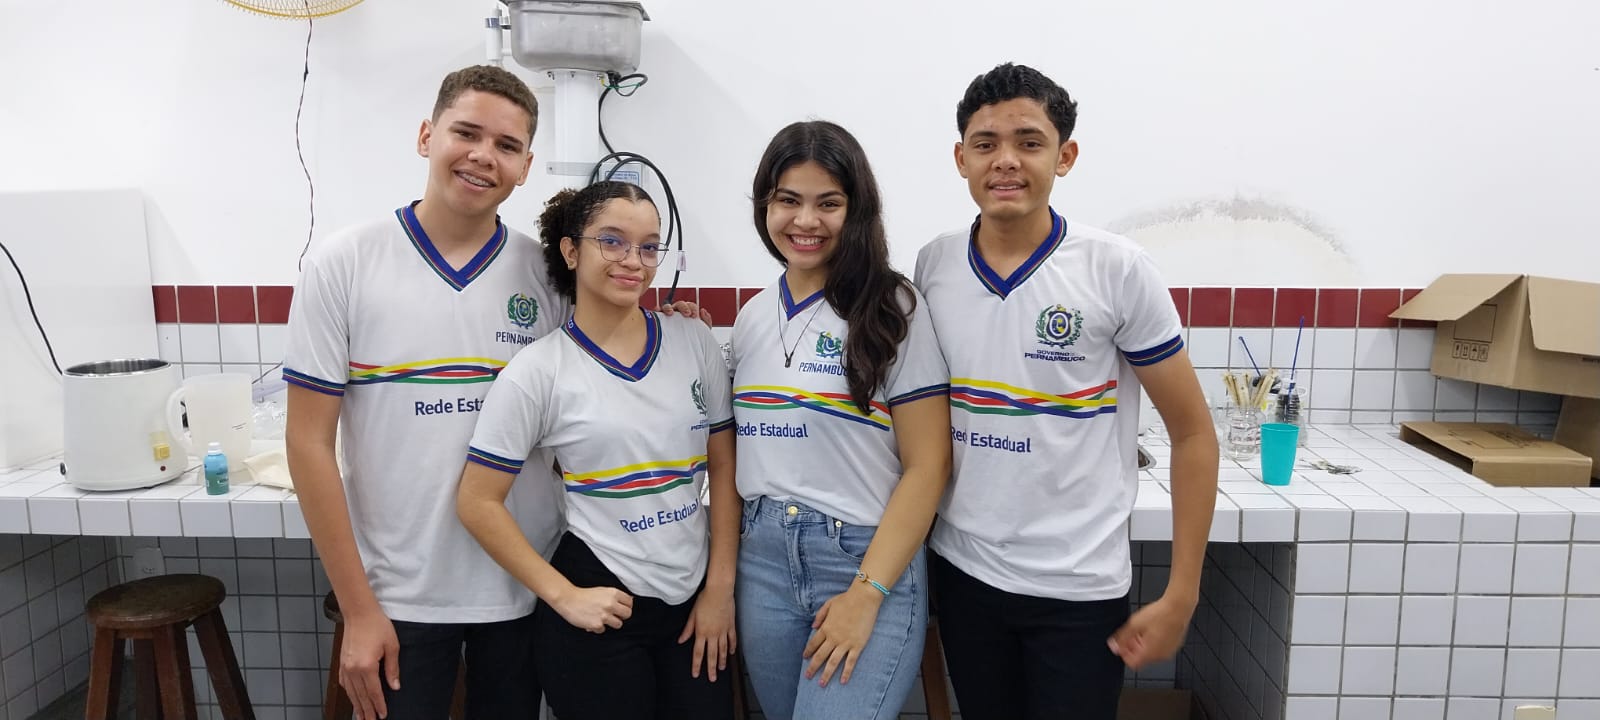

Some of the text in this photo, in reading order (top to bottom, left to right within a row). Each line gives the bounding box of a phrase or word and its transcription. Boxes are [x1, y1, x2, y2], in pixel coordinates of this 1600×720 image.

[1024, 352, 1086, 362] PERNAMBUCO
[414, 398, 453, 416] Rede
[760, 423, 808, 438] Estadual
[970, 432, 1031, 453] Estadual
[619, 515, 655, 533] Rede
